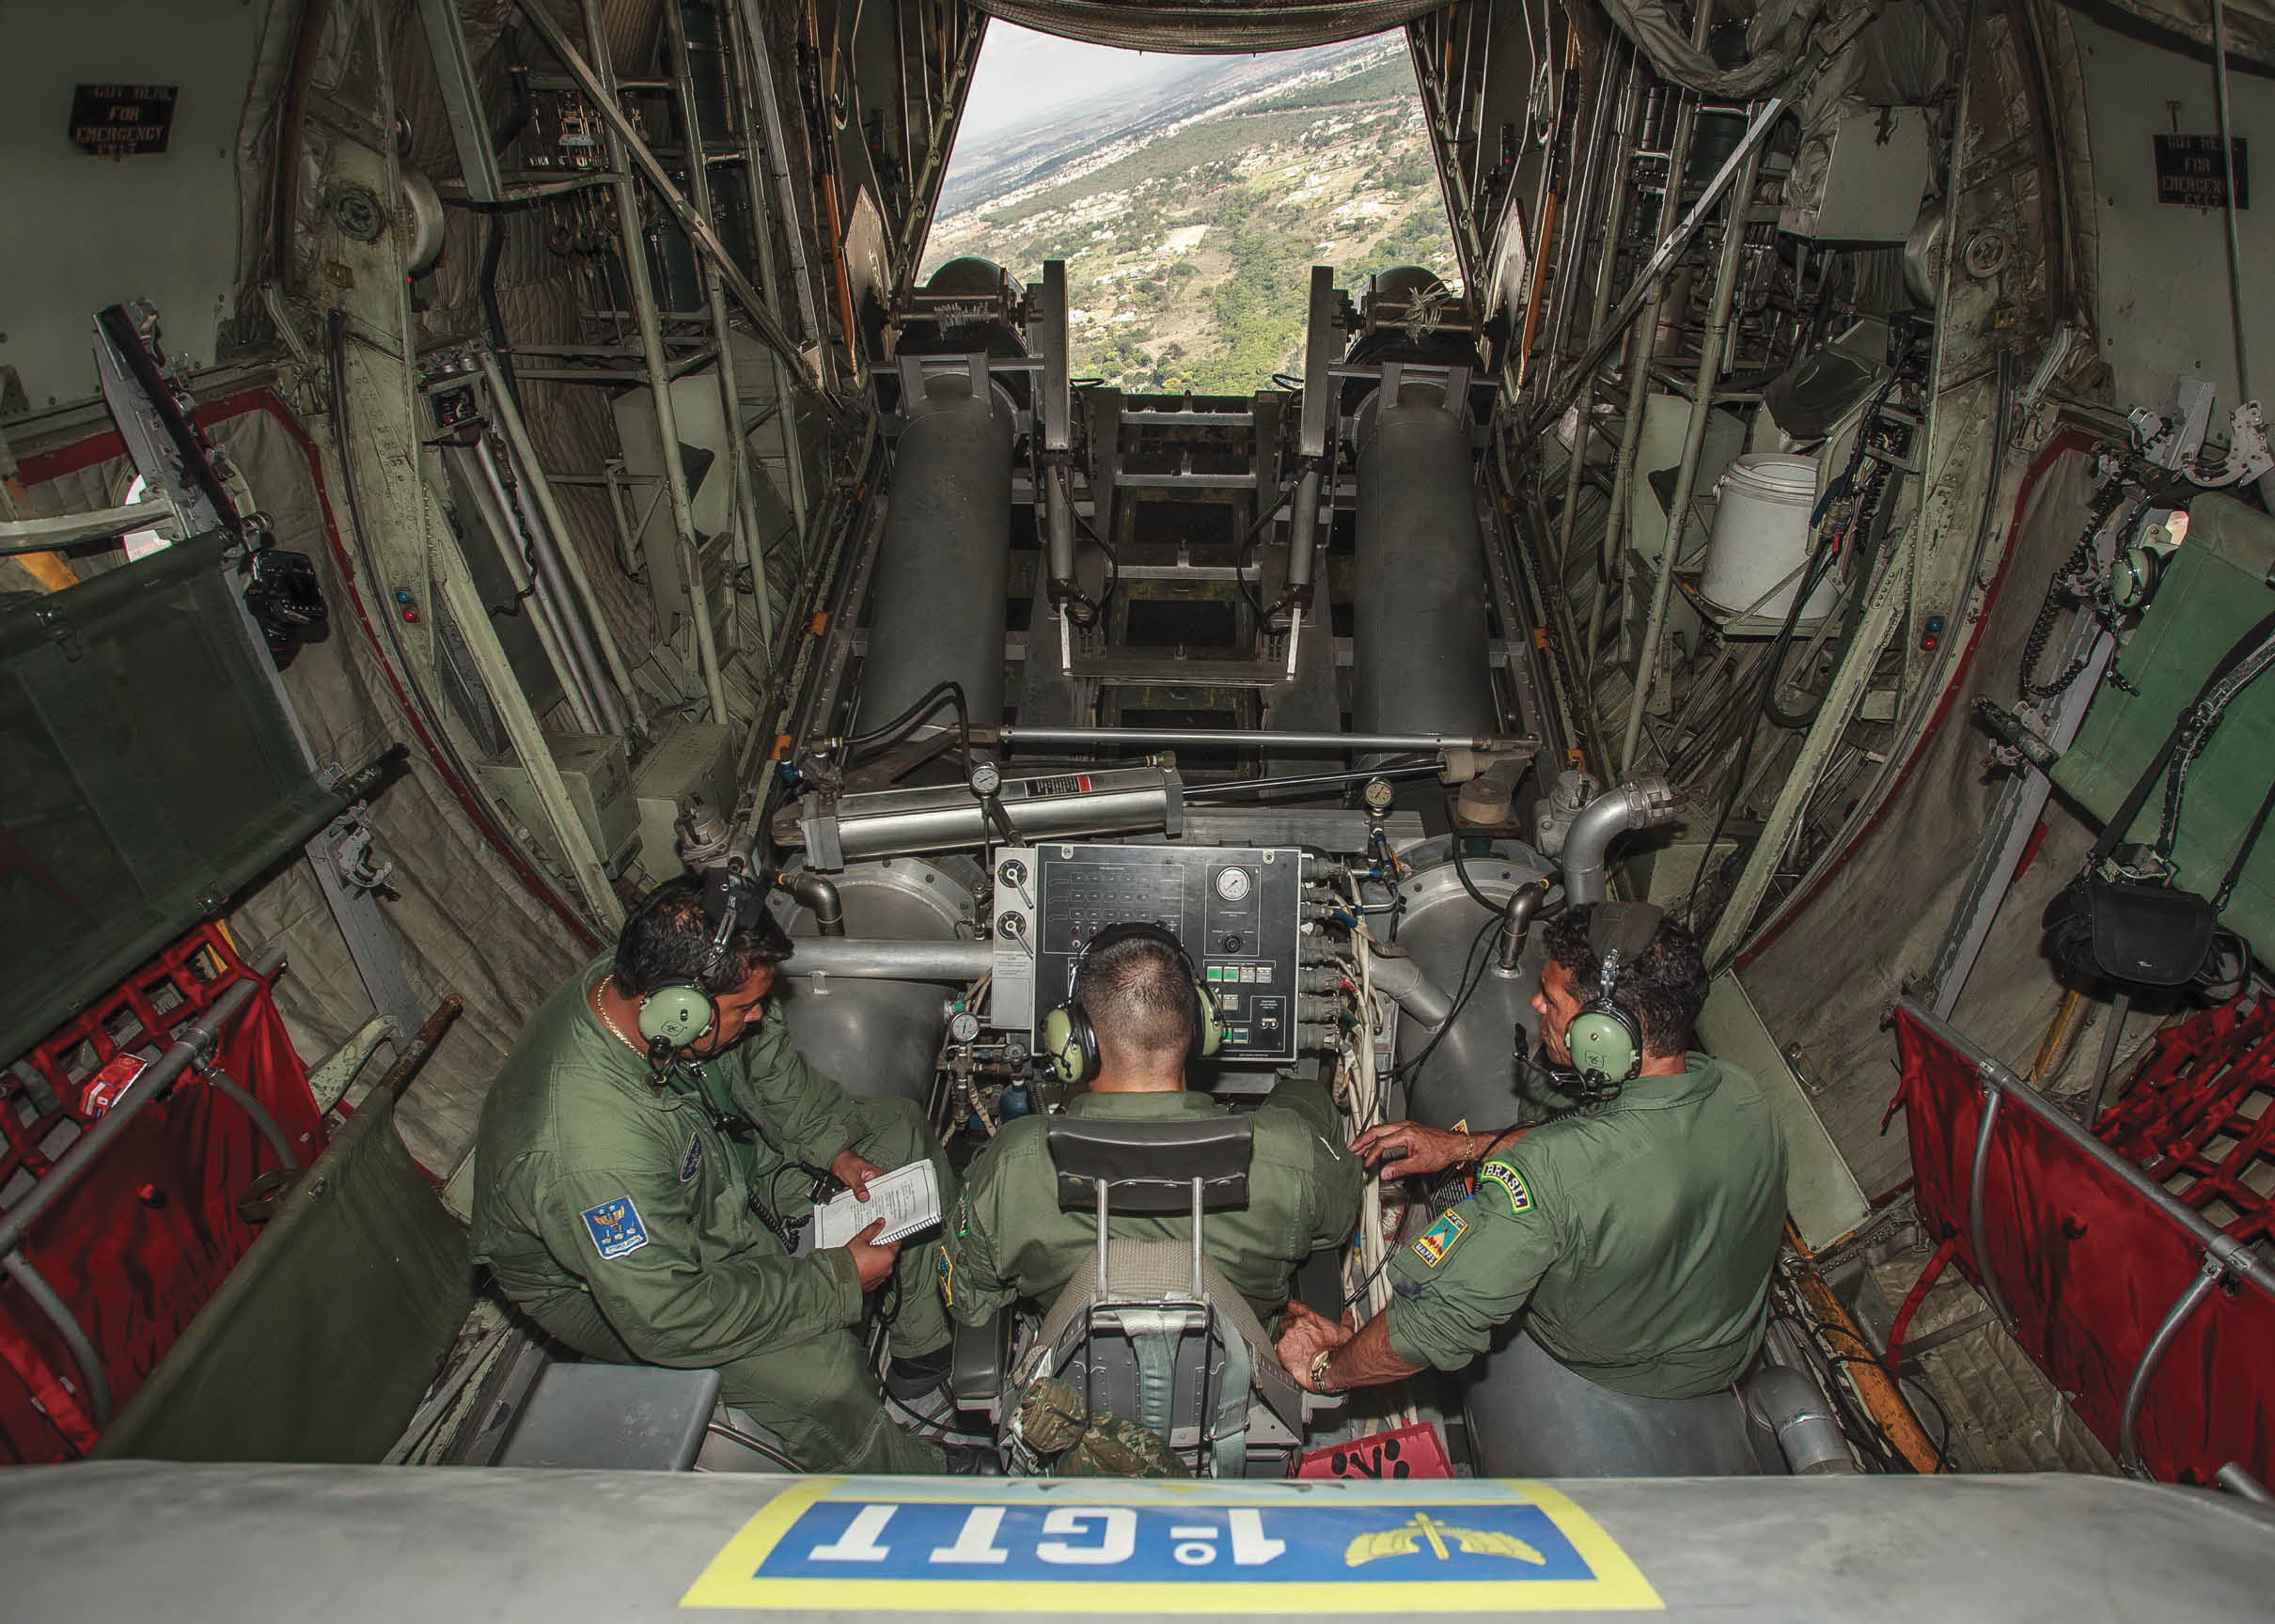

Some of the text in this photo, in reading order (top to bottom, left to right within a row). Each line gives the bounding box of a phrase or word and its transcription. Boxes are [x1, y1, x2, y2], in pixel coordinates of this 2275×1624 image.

[108, 105, 140, 120] FOR
[75, 126, 165, 143] EMERGENCY
[2184, 157, 2212, 173] FOR
[1485, 1163, 1529, 1208] BRASIL
[808, 1504, 1138, 1565] GTT
